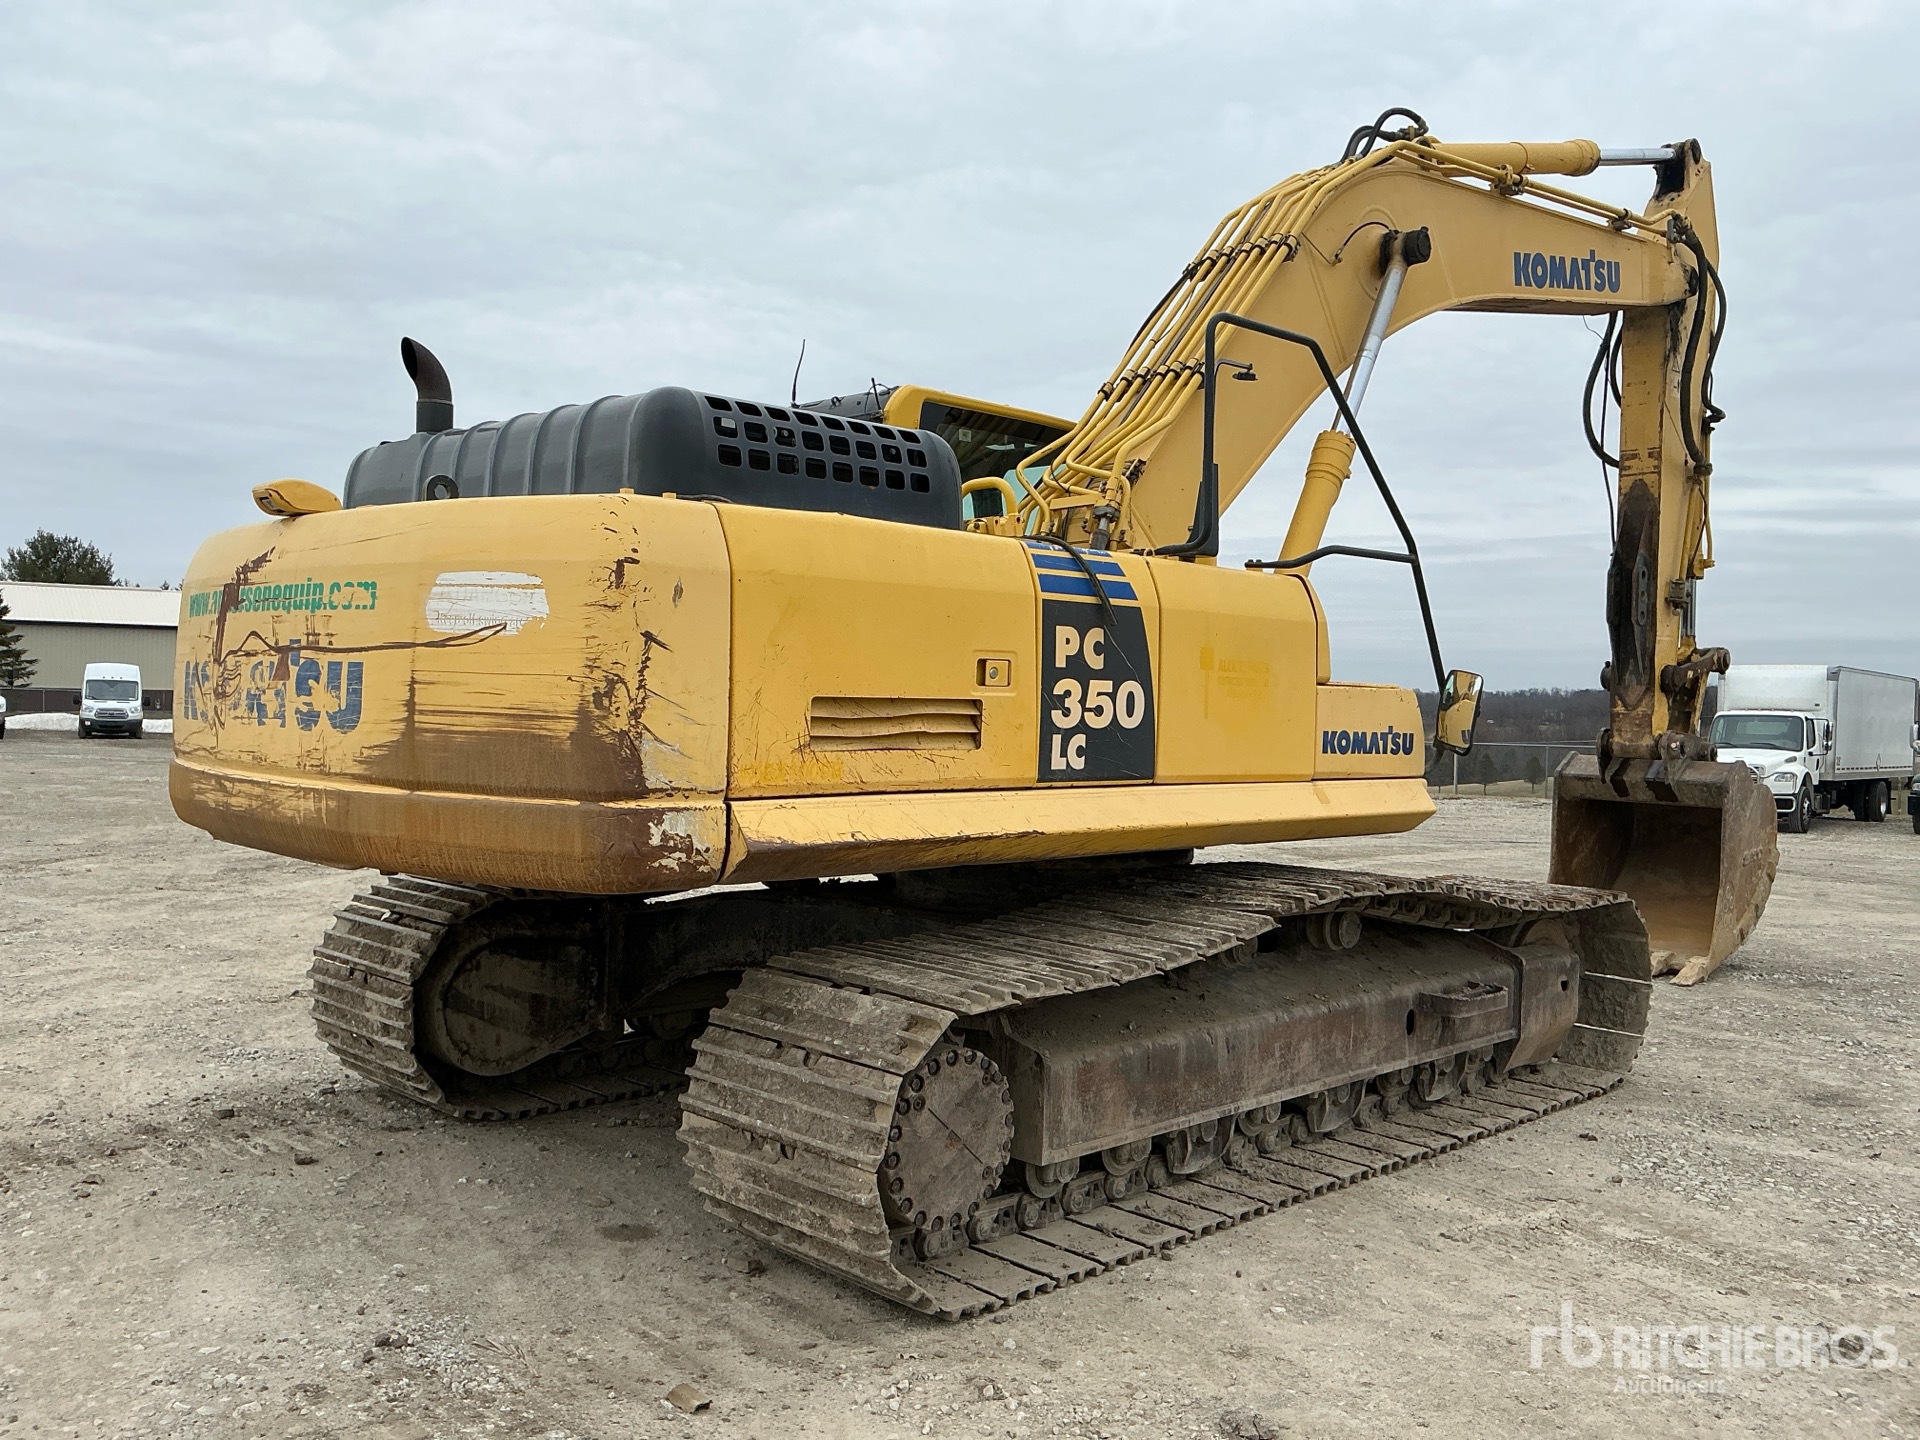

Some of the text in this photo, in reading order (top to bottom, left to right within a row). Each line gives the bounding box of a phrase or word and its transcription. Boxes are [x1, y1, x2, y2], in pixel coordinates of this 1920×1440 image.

[1513, 249, 1621, 293] KOMATSU
[188, 577, 378, 617] www.anrsonequip.com
[1055, 625, 1106, 670] PC
[1051, 679, 1146, 730] 350
[1051, 733, 1087, 770] LC
[1321, 725, 1415, 756] KOMATSU
